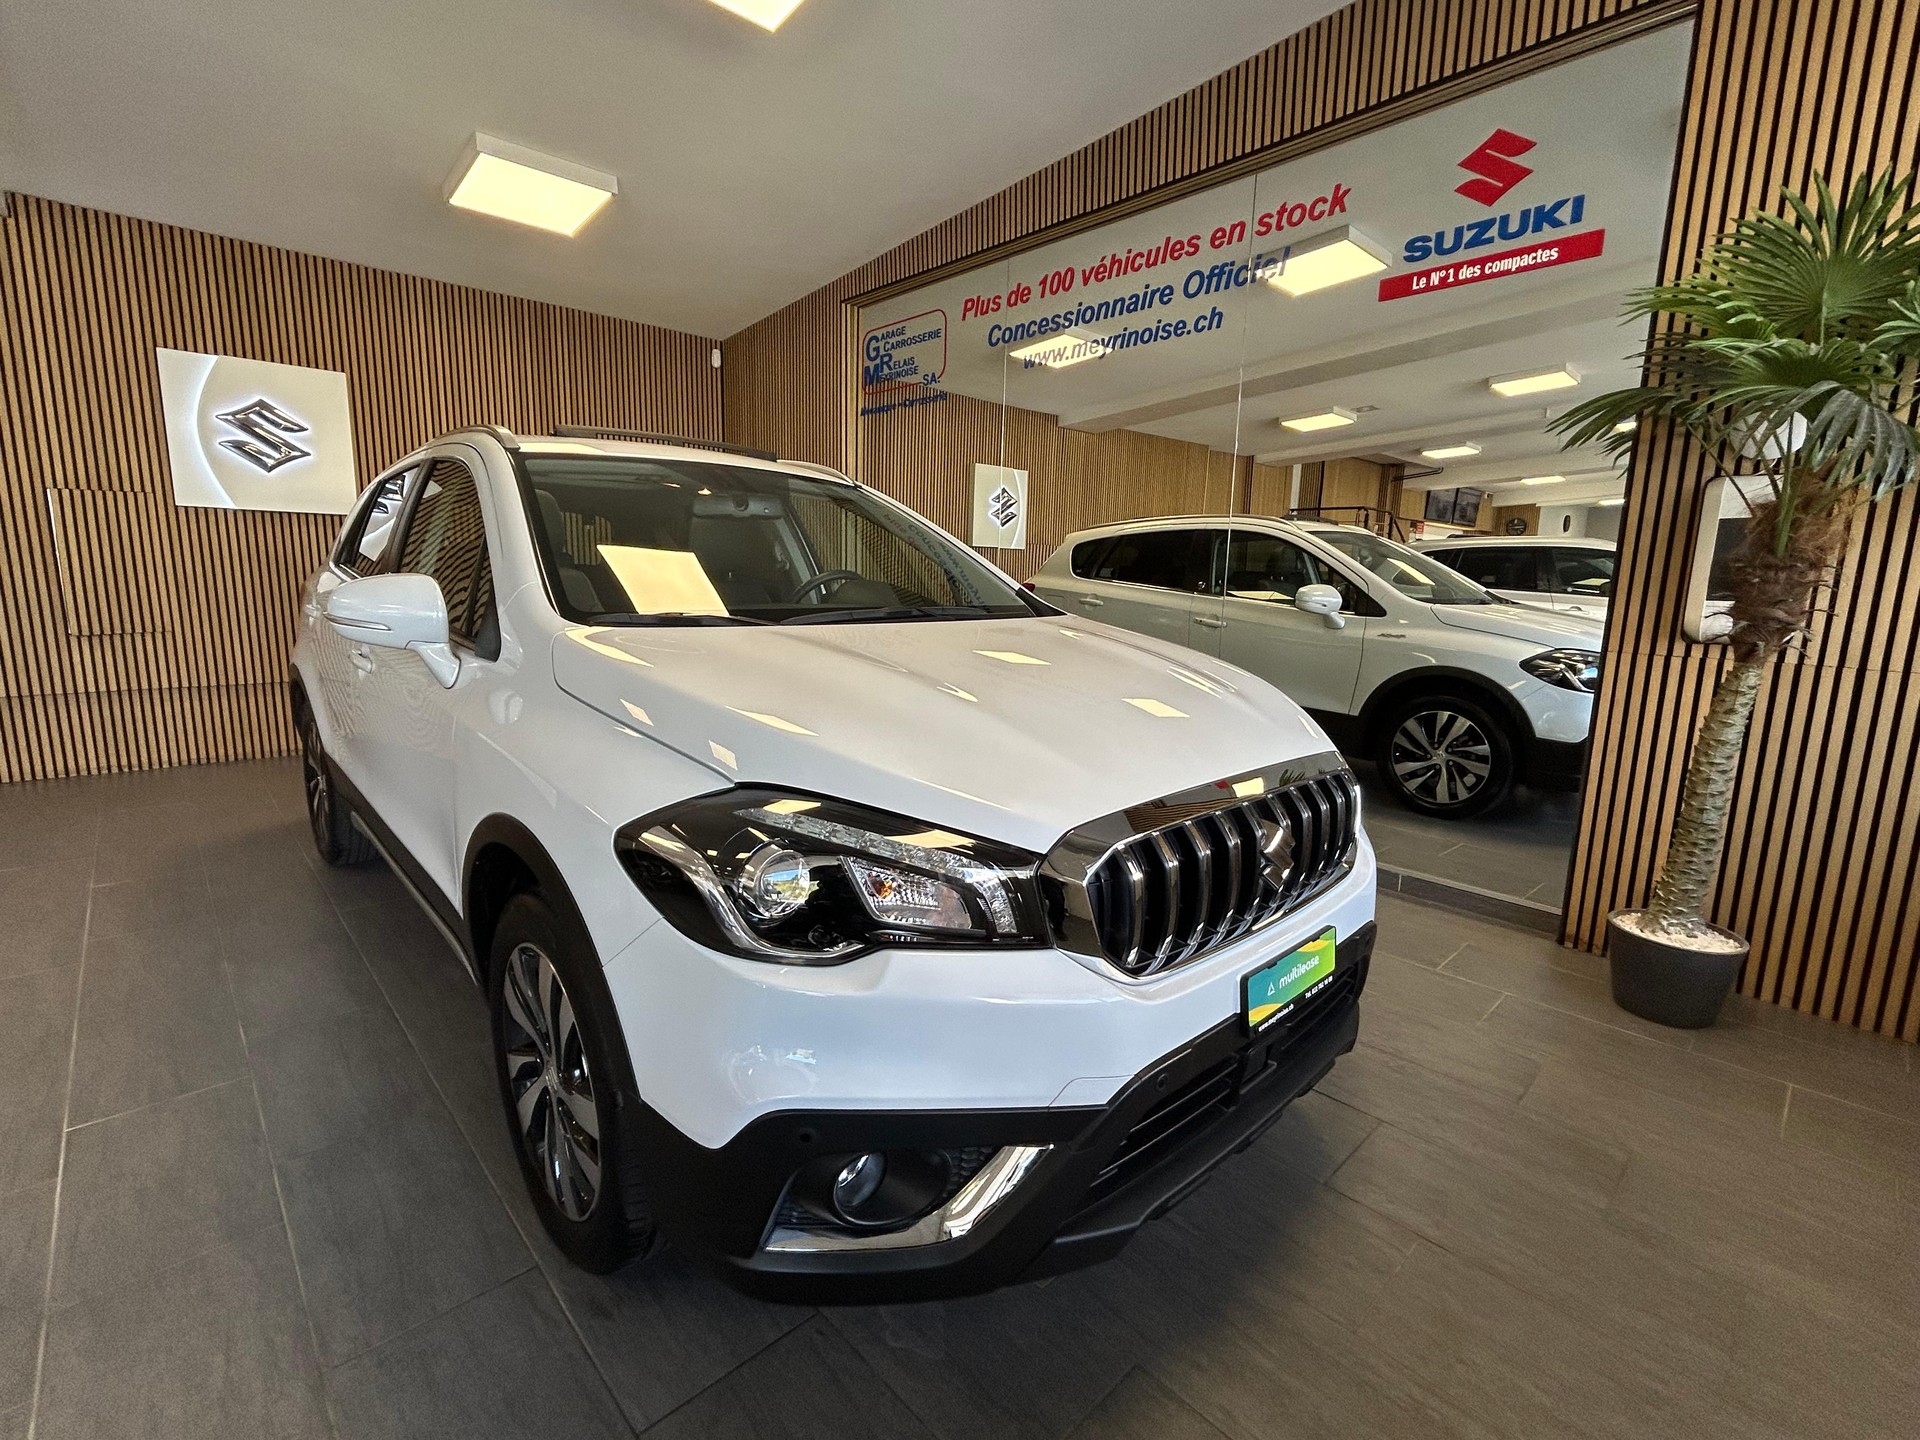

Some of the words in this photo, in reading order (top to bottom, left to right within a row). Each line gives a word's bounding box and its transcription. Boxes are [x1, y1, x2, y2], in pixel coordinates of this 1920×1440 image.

[961, 294, 1002, 321] Plus
[1006, 282, 1032, 308] de
[1038, 266, 1075, 299] 100
[1081, 234, 1202, 287] véhicules
[1209, 219, 1247, 249] en
[1254, 182, 1352, 237] stock
[1403, 194, 1585, 263] SUZUKI
[1412, 275, 1426, 290] Le
[1458, 264, 1481, 280] des
[1484, 247, 1559, 274] compactes
[883, 328, 942, 353] CARROSSERIE
[987, 283, 1175, 348] Concessionnaire
[1023, 306, 1224, 370] www.meyrinoise.ch
[880, 353, 915, 374] RELAIS
[1279, 955, 1319, 988] multilease
